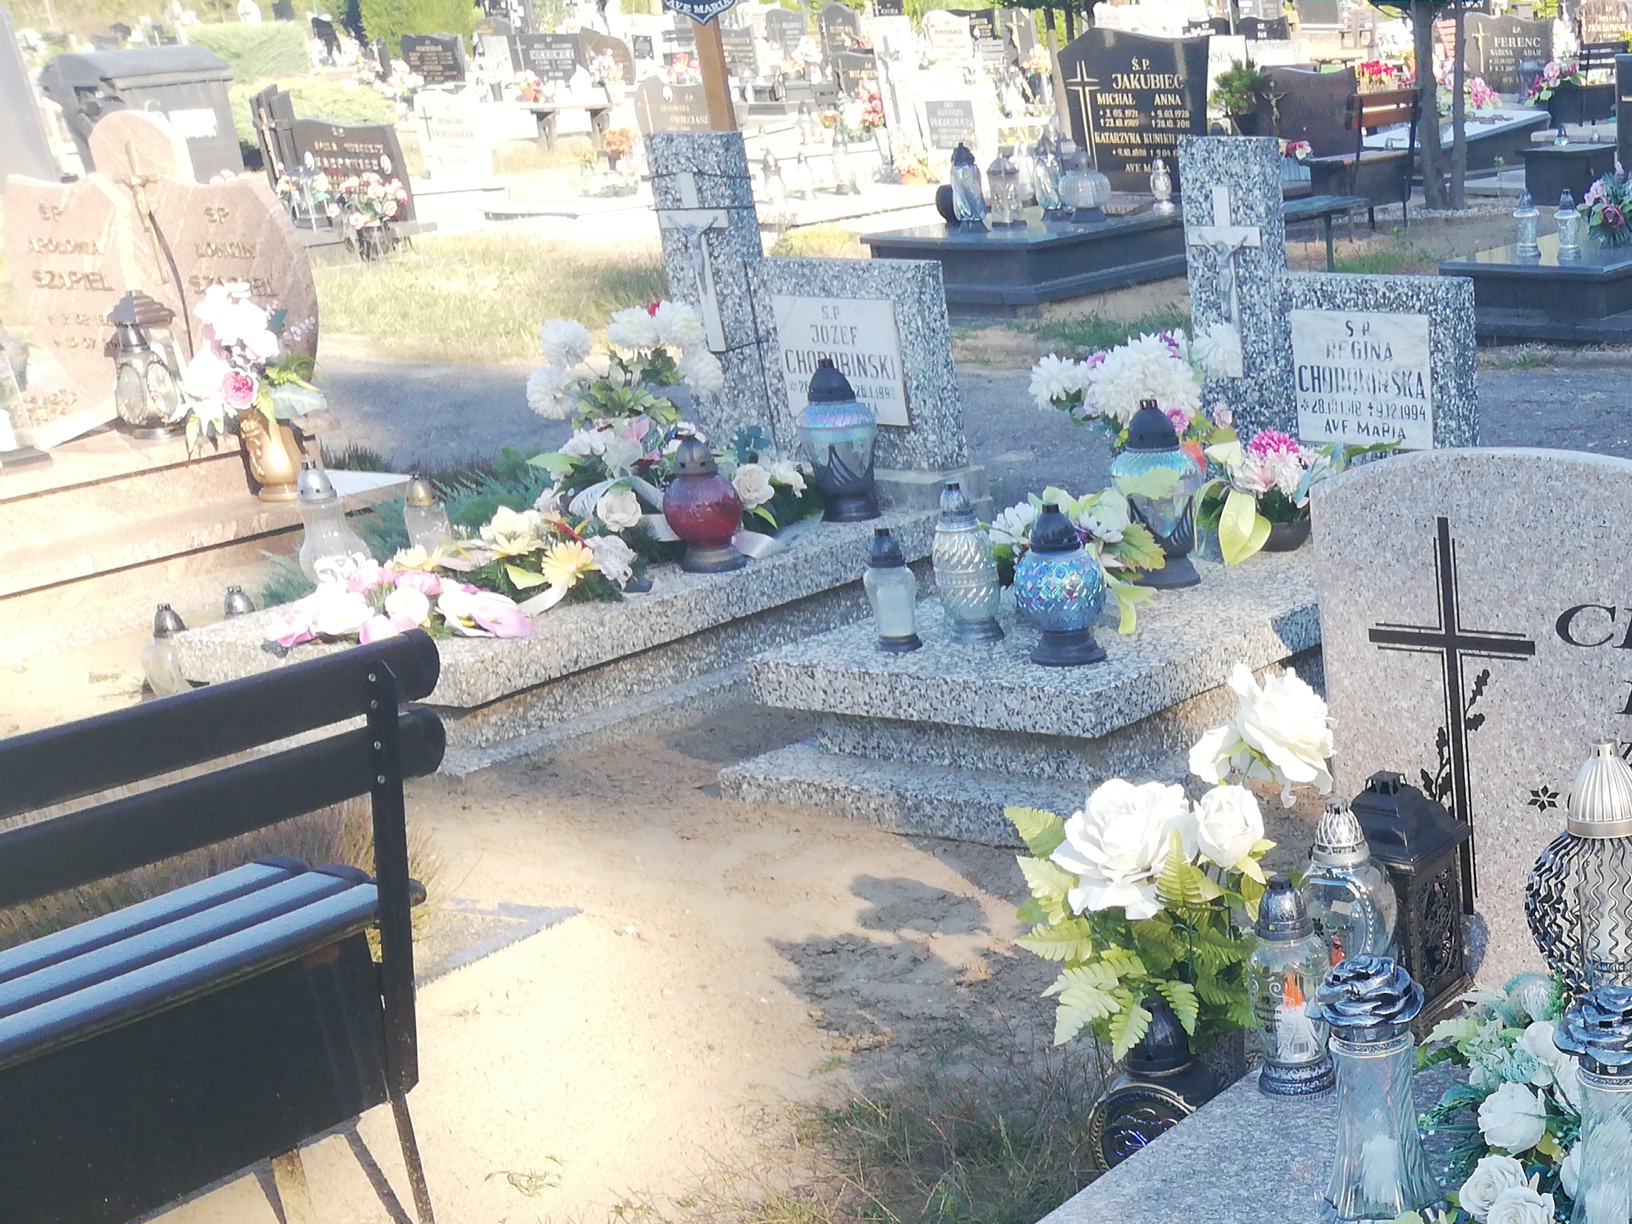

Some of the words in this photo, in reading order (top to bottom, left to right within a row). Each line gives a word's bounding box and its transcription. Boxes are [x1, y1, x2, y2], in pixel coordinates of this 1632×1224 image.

[665, 0, 691, 13] AVE
[693, 0, 733, 13] MARIA
[1494, 37, 1541, 48] FERENC
[1112, 74, 1184, 90] JAKUBIEC
[1097, 93, 1136, 106] MICHAŁ
[1153, 93, 1182, 106] ANNA
[1094, 131, 1141, 145] KATARZYNA
[1326, 339, 1393, 363] REGINA
[1324, 418, 1348, 435] AVE
